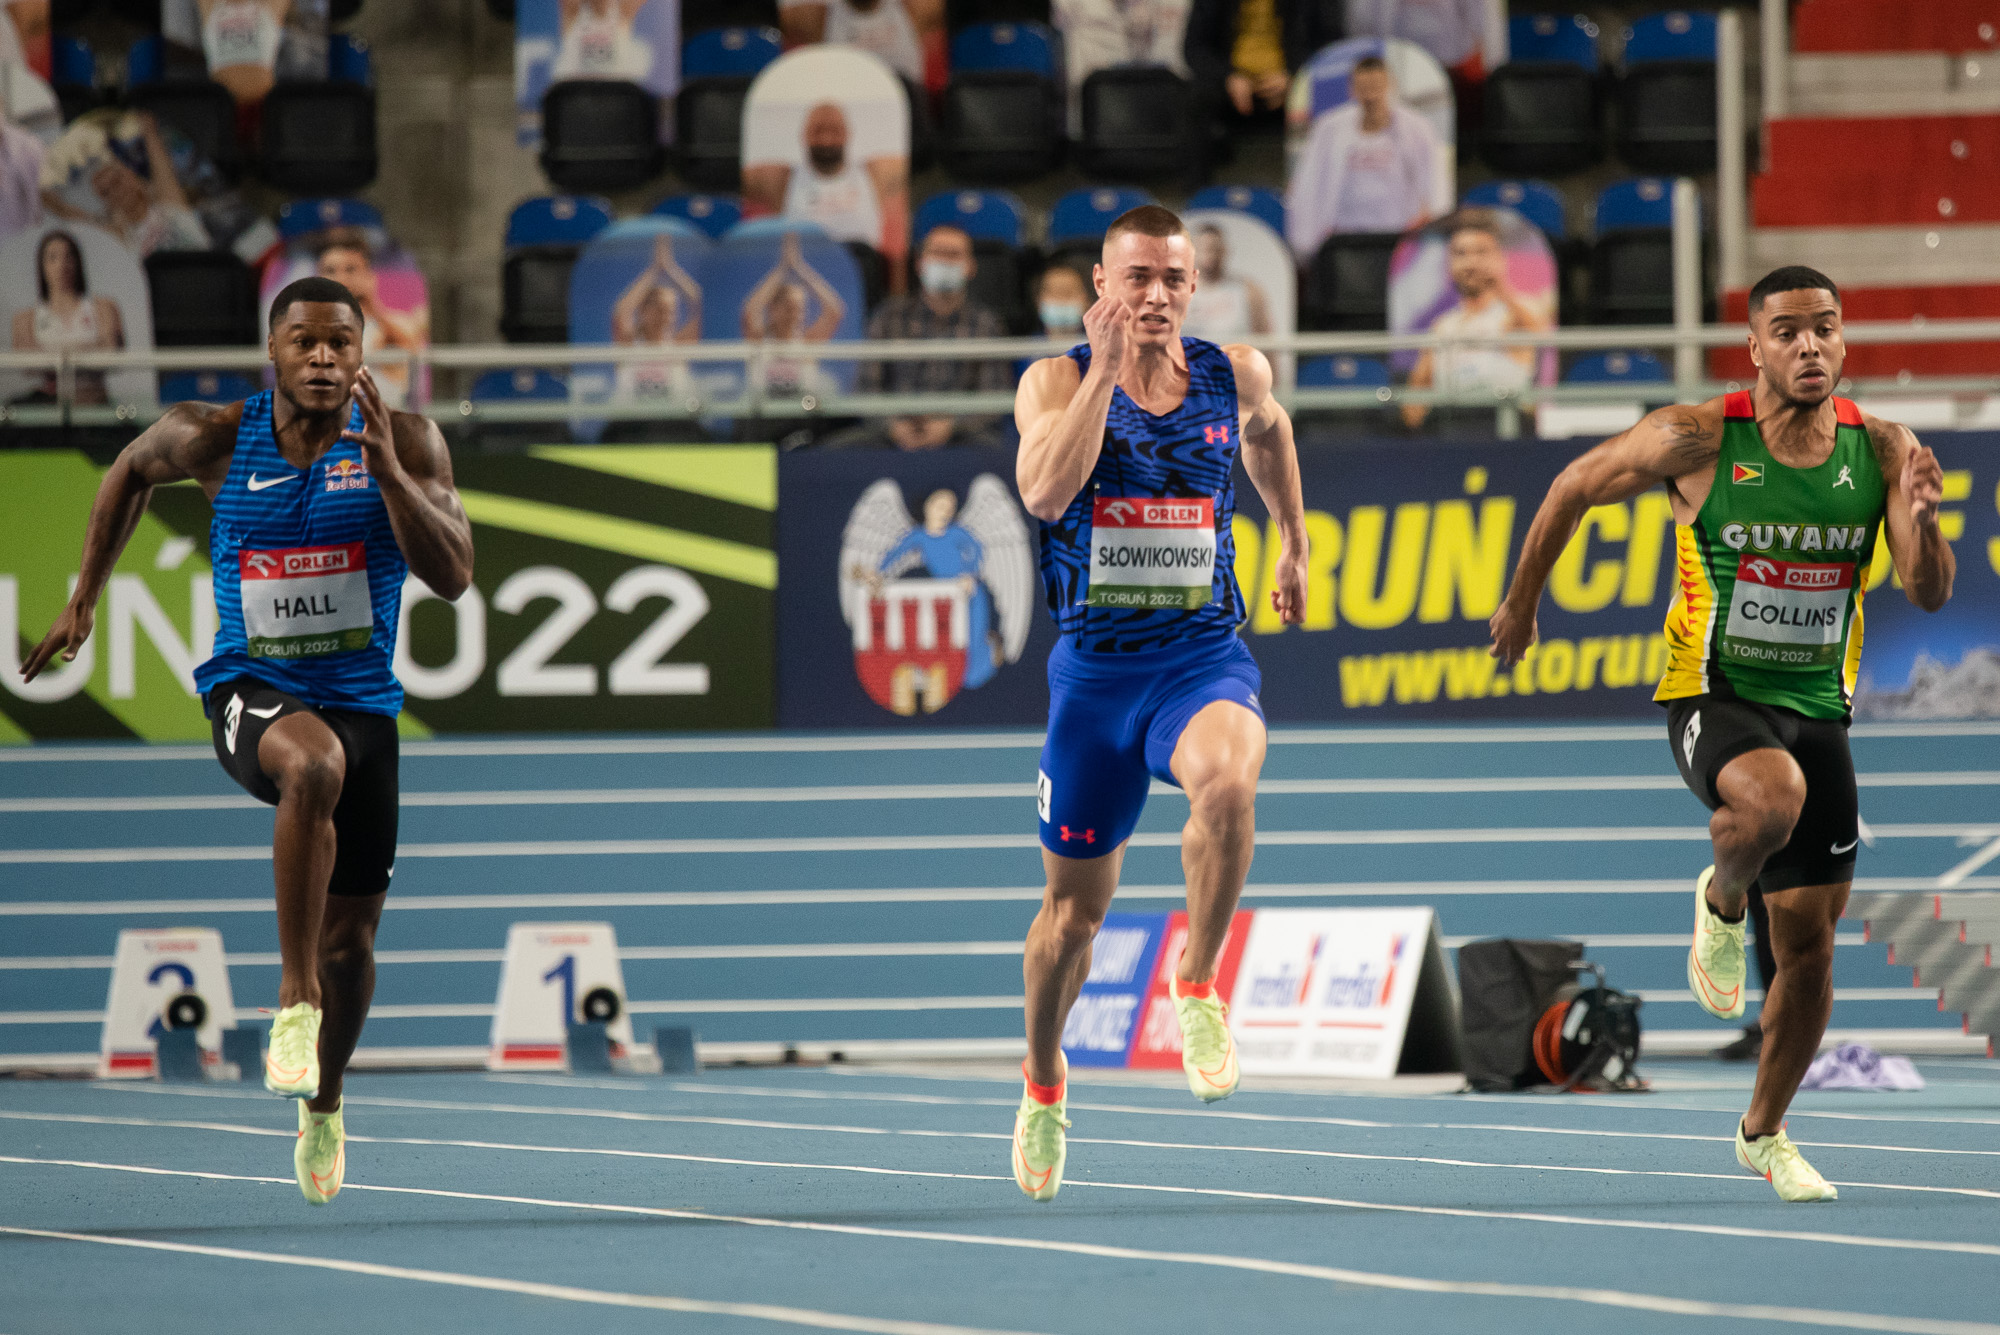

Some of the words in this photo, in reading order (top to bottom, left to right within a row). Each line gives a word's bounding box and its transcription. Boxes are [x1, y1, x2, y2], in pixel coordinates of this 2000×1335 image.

[325, 478, 346, 491] Red
[347, 476, 369, 489] Bull
[1147, 508, 1199, 521] ORLEN
[1722, 523, 1866, 551] GUYANA
[288, 553, 345, 571] ORLEN
[1099, 546, 1212, 568] SŁOWIKOWSKI
[1788, 570, 1838, 584] ORLEN
[273, 595, 338, 619] HALL
[1100, 591, 1146, 605] TORUŃ
[1149, 593, 1183, 605] 2022
[1741, 600, 1837, 628] COLLINS
[256, 641, 301, 656] TORUŃ
[304, 639, 340, 653] 2022
[1732, 643, 1778, 661] TORUŃ
[1780, 650, 1814, 663] 2022
[1685, 723, 1695, 755] 3
[147, 962, 197, 1037] 2
[544, 954, 575, 1025] 1
